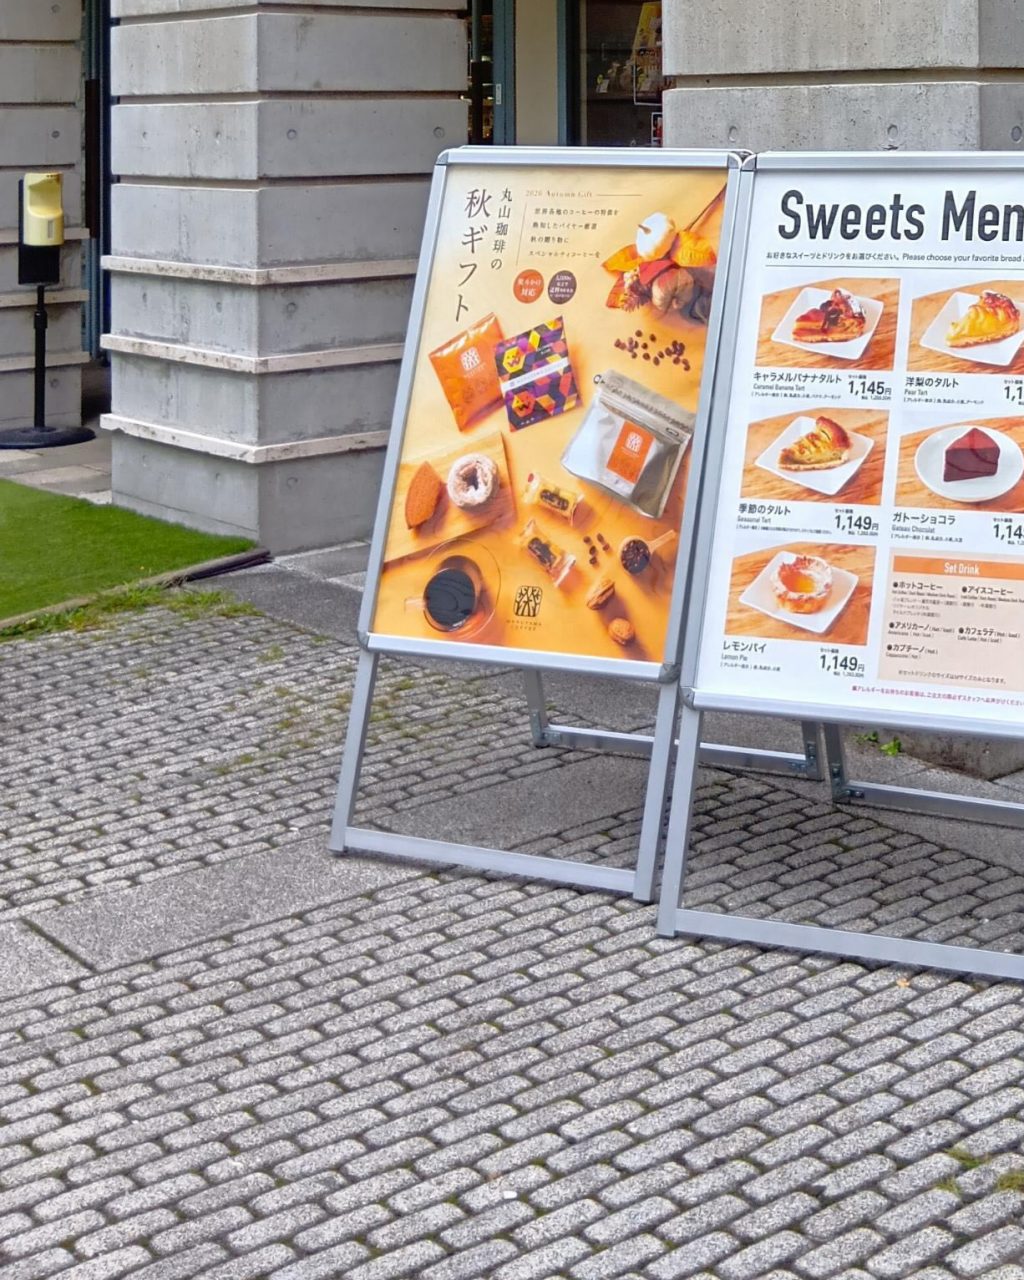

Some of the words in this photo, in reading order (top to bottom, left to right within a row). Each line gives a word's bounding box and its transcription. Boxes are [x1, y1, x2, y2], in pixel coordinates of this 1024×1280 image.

[778, 189, 926, 241] Sweets
[491, 187, 513, 270] 丸山珈琲の
[456, 188, 492, 322] 秋ギフト
[766, 251, 900, 261] お好きなスイーツとドリンクをお選びください。
[902, 253, 925, 261] Please
[927, 253, 952, 261] choose
[972, 254, 999, 262] favorite
[1000, 254, 1021, 262] bread
[753, 372, 842, 384] キャラメルバナナタルト
[905, 376, 959, 388] 洋梨のタルト
[738, 503, 791, 515] 季節のタルト
[892, 512, 956, 525] ガトーショコラ
[944, 562, 957, 574] Set
[958, 563, 980, 575] Drink
[898, 581, 943, 591] ホットコーヒー
[967, 586, 1013, 596] アイスコーヒー
[894, 622, 930, 631] アメリカーノ
[964, 626, 994, 637] カフェラテ
[723, 641, 767, 653] レモンパイ
